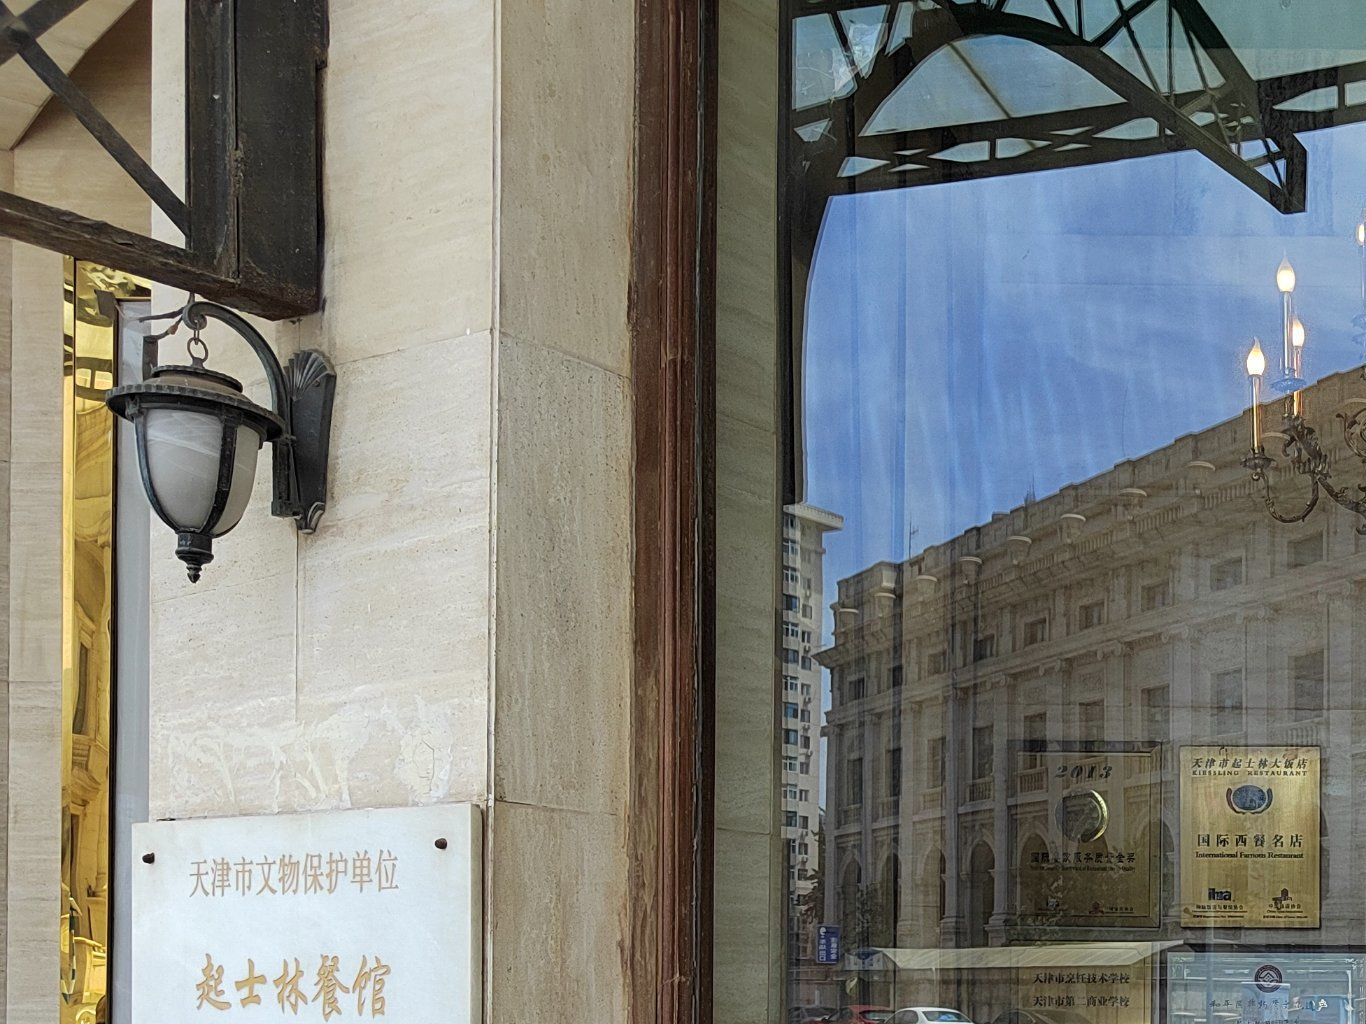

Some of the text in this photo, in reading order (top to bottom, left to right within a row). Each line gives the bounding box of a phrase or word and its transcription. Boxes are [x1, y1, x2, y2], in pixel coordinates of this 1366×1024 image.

[1192, 758, 1308, 769] 天津市起士林大饭店
[1055, 766, 1112, 779] 2013
[1197, 834, 1303, 847] 国际西餐名店
[189, 849, 399, 898] 天津市文物保护单位
[1033, 973, 1130, 984] 天津市烹饪技术学校
[196, 953, 392, 1023] 起士林餐馆
[1033, 996, 1130, 1007] 天津市第二商业学校
